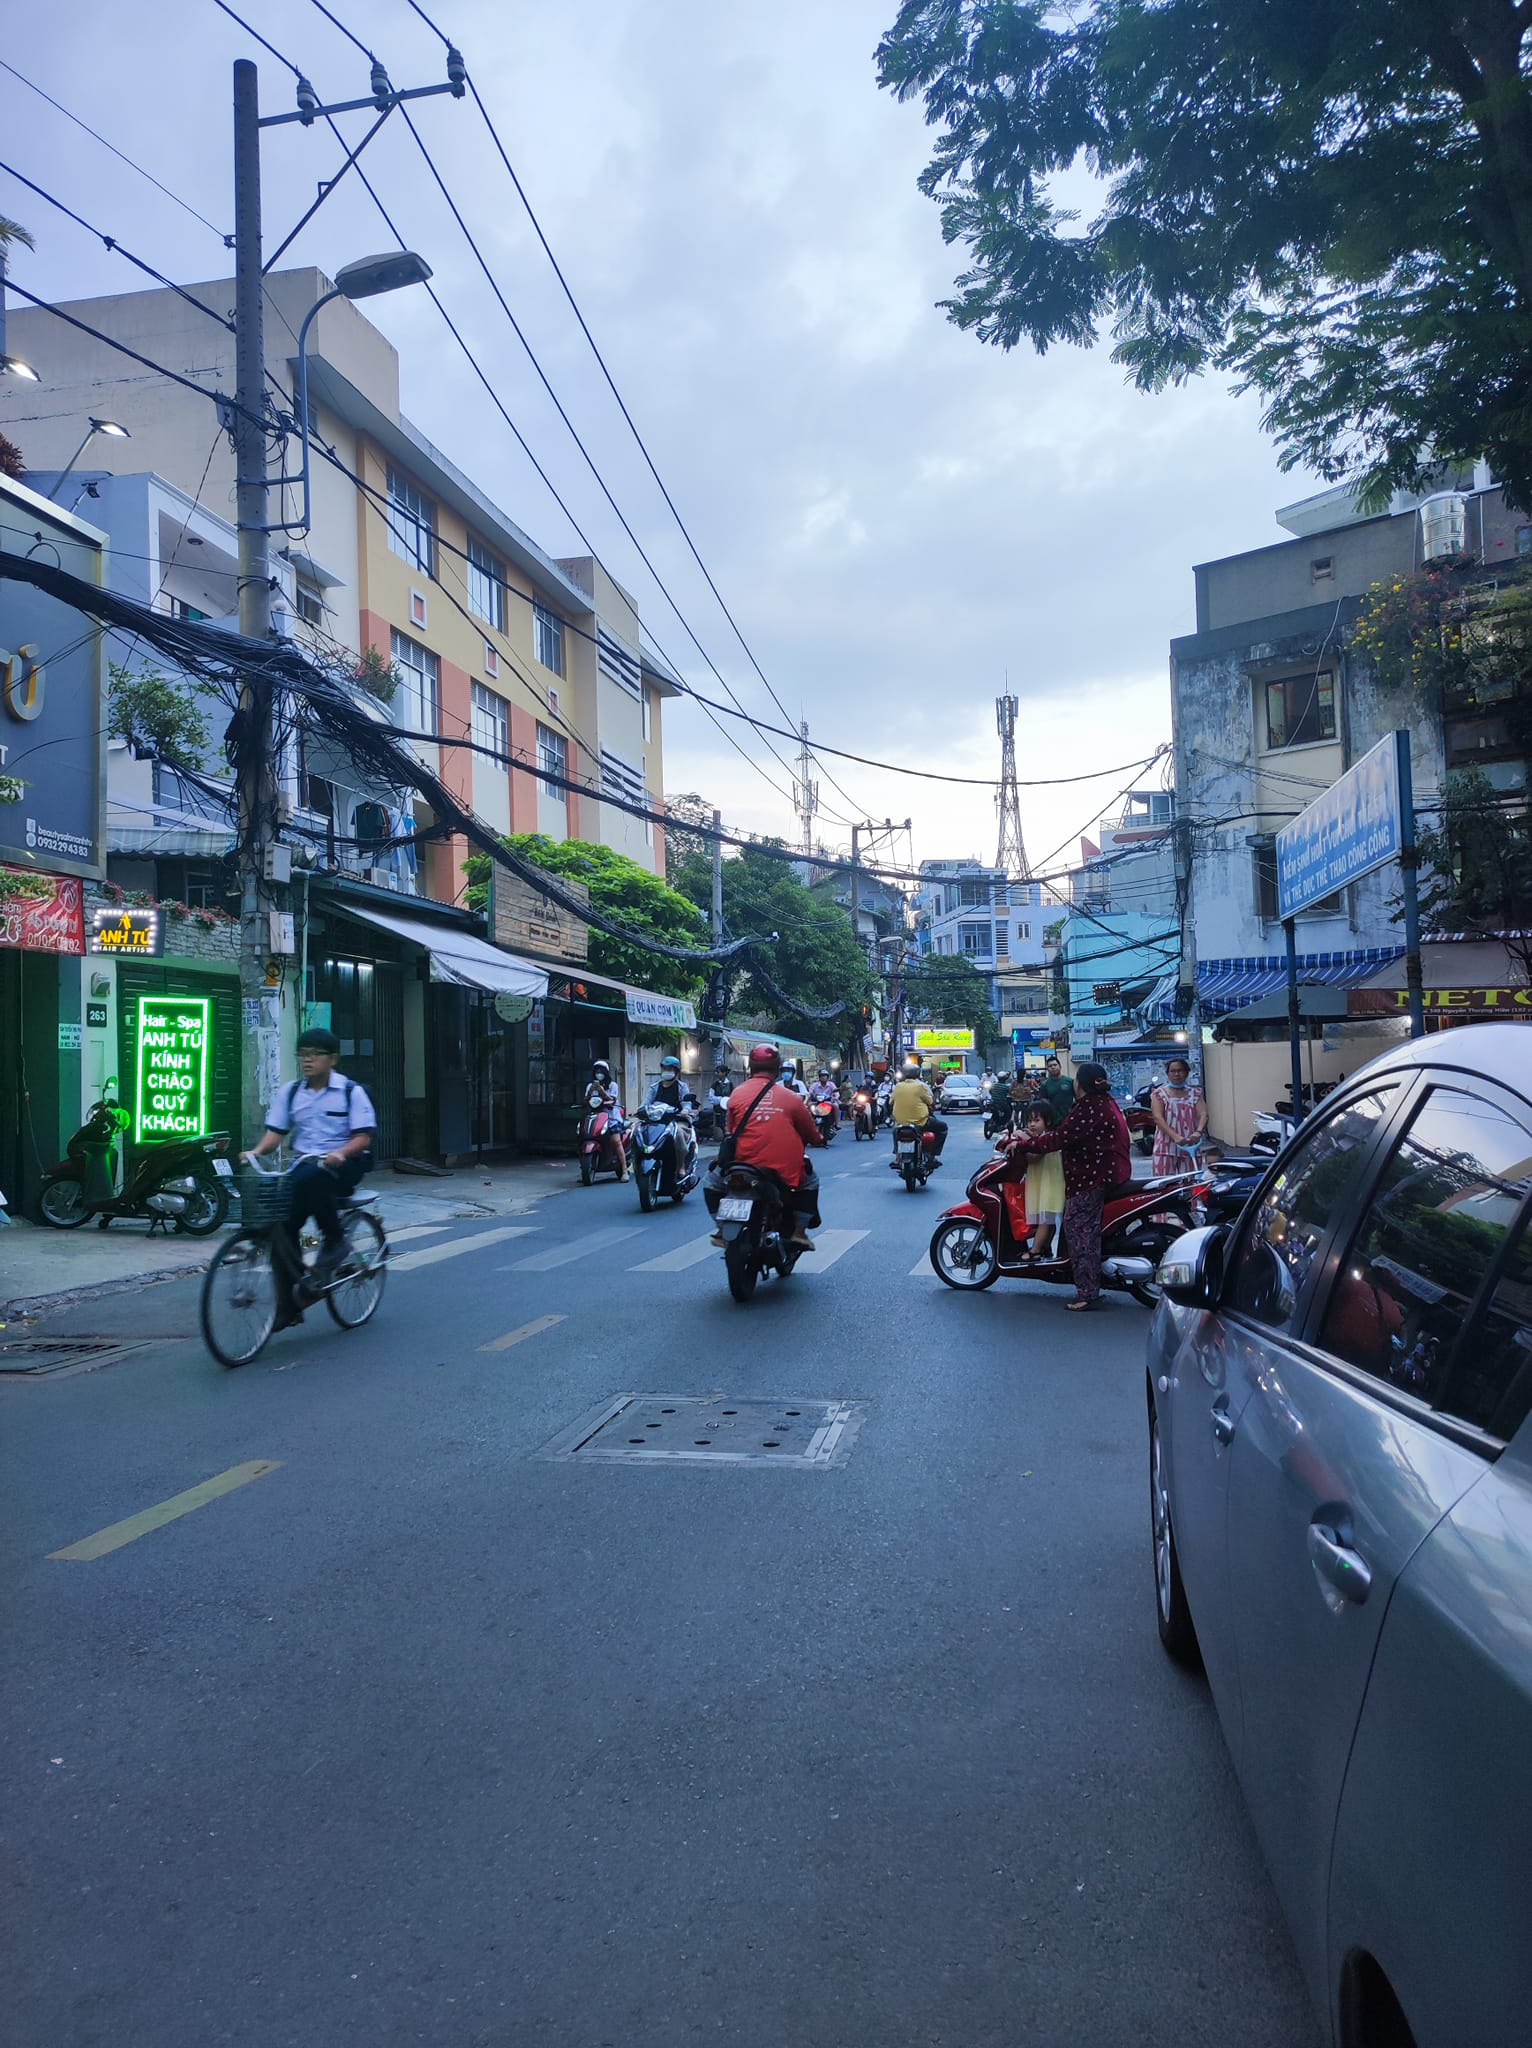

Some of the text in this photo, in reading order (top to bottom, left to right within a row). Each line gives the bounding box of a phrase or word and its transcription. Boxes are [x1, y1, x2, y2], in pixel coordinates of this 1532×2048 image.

[1329, 854, 1347, 881] THAO
[1348, 841, 1367, 869] CÔNG
[1368, 825, 1390, 859] CỘNG
[99, 927, 152, 945] ANH TÚ
[90, 1010, 106, 1021] 263
[636, 999, 656, 1015] QUÁN
[657, 1004, 672, 1017] CƠM
[143, 1014, 167, 1027] Hair
[177, 1015, 202, 1030] Spa
[142, 1029, 202, 1049] ANH TÚ
[151, 1050, 190, 1069] KÍNH
[147, 1072, 193, 1090] CHÀO
[152, 1093, 187, 1111] QUÝ
[142, 1112, 199, 1132] KHÁCH
